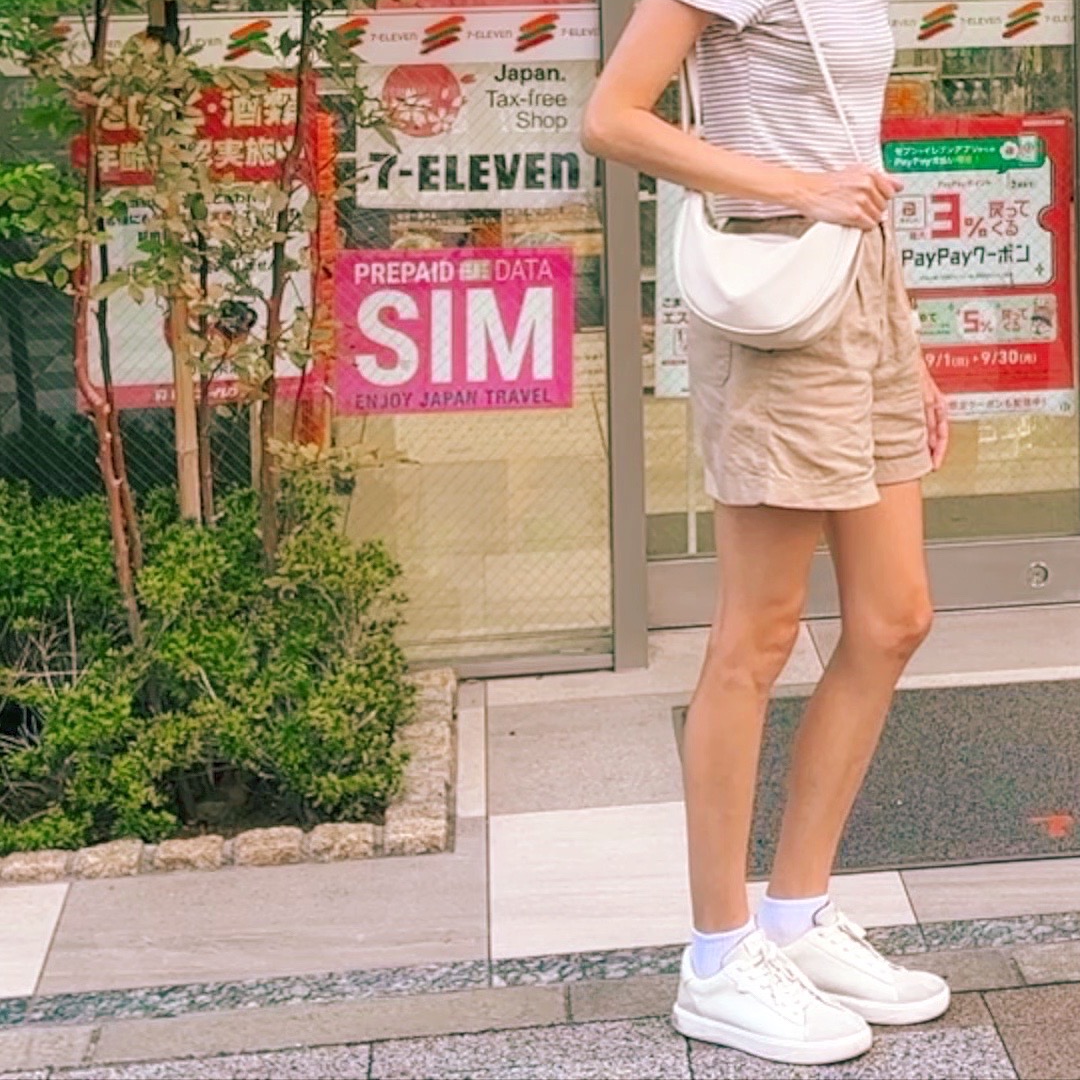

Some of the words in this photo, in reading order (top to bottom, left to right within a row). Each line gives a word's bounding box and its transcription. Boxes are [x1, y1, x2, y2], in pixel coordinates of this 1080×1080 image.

[494, 63, 566, 86] Japan.
[485, 88, 568, 109] Tax-free
[516, 111, 568, 133] Shop
[353, 259, 455, 285] PREPAID
[494, 257, 554, 282] DATA
[354, 286, 554, 387] SIM
[354, 392, 414, 410] ENJOY
[419, 390, 478, 408] JAPAN
[485, 387, 552, 406] TRAVEL
